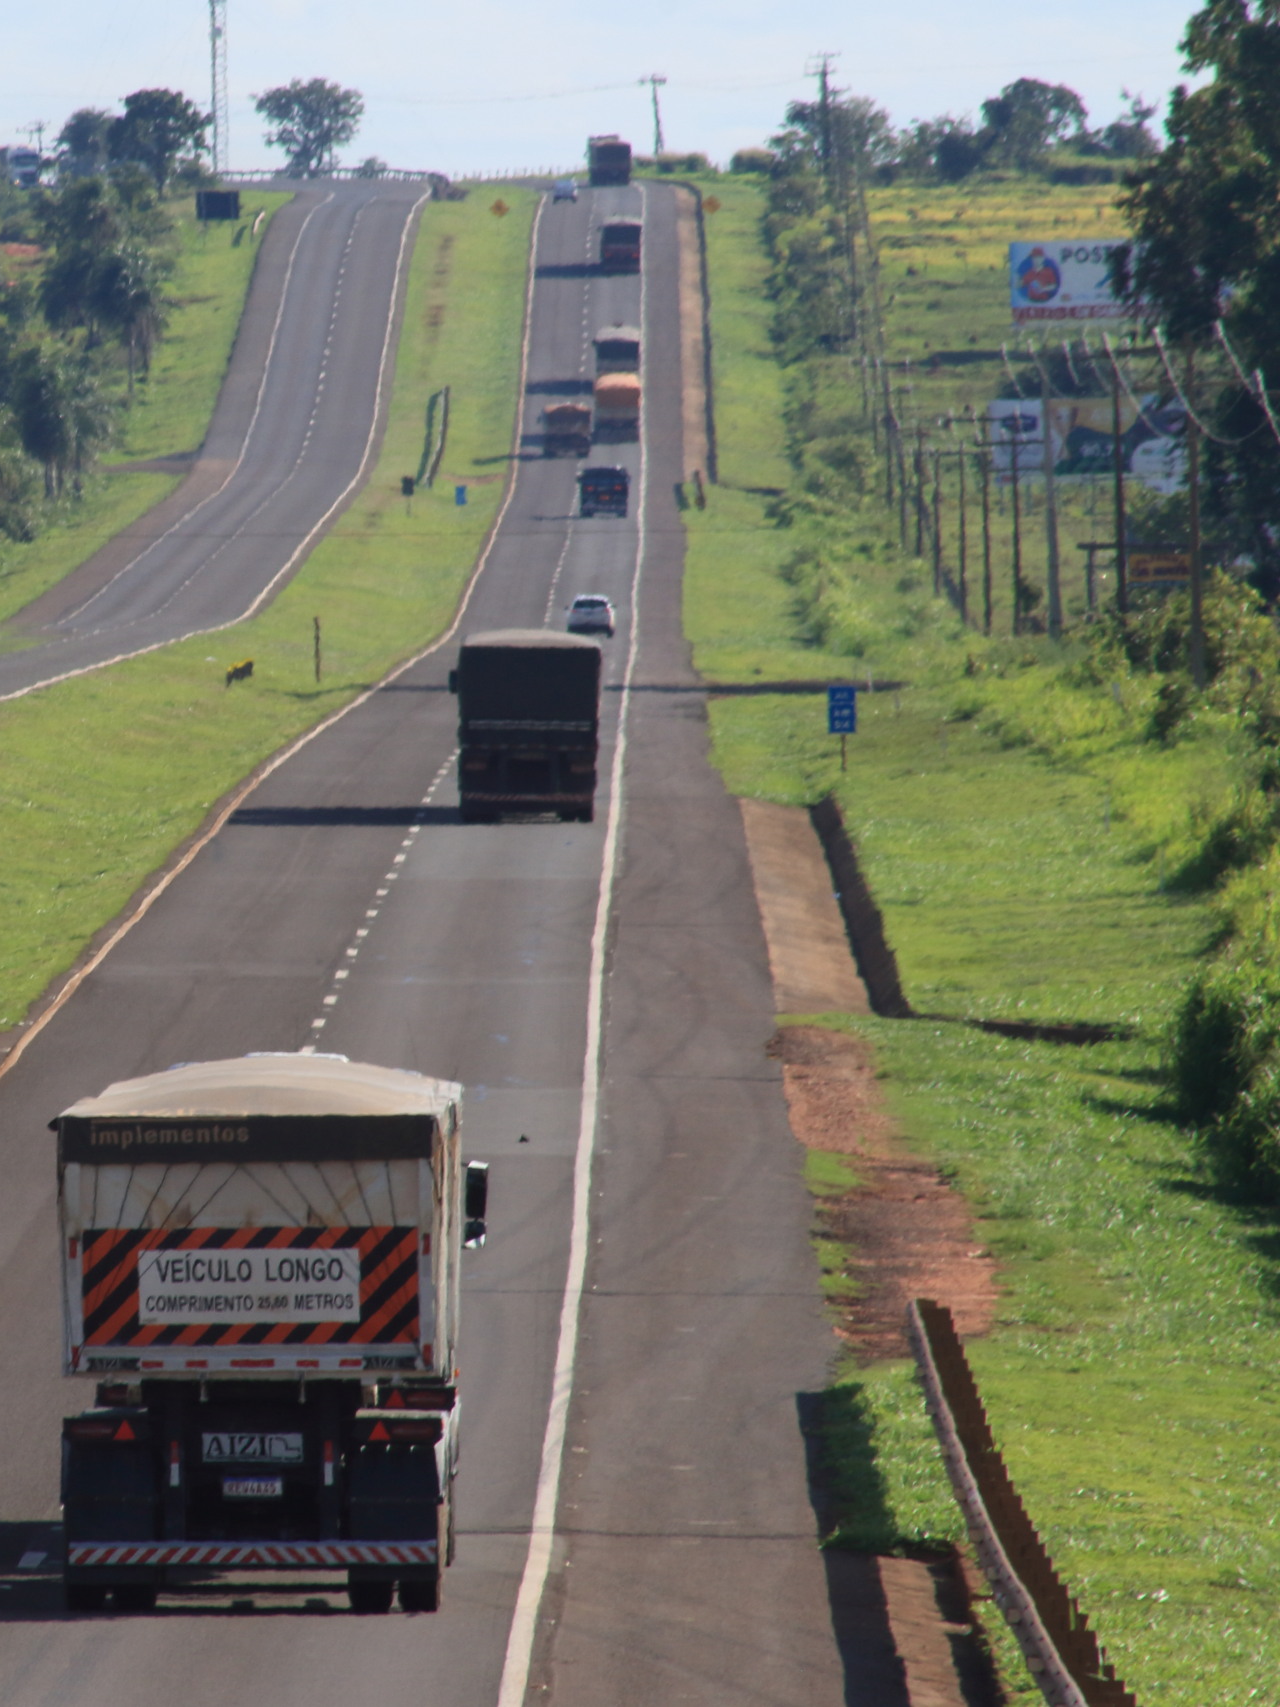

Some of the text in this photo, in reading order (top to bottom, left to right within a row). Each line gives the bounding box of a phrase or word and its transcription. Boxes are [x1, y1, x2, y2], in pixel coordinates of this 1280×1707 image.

[90, 1124, 249, 1150] implementos
[155, 1252, 344, 1282] VEÍCULO LONGO
[145, 1294, 254, 1312] COMPRIMENTO
[294, 1293, 354, 1310] METROS
